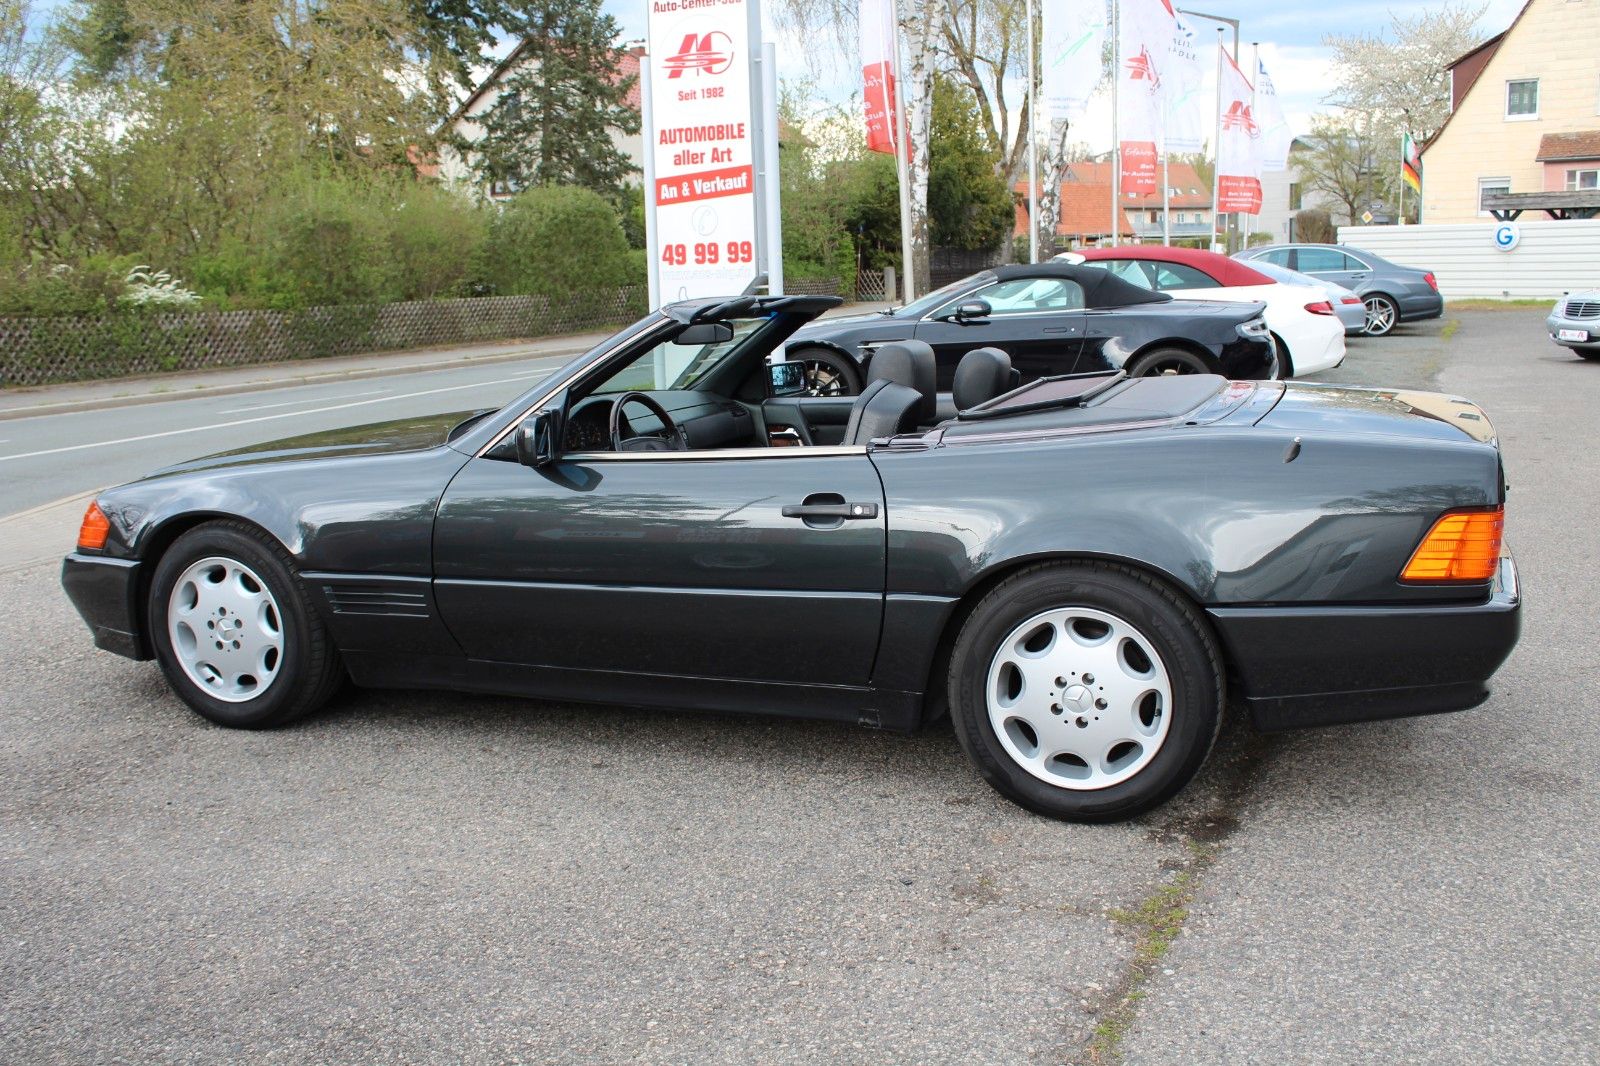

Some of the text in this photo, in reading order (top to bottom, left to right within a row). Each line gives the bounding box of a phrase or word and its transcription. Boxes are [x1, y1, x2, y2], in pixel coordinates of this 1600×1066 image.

[678, 87, 724, 101] Seit 1982
[659, 123, 745, 145] AUTOMOBILE
[674, 147, 732, 166] aller Art
[661, 172, 748, 200] An & Verkauf
[662, 241, 752, 266] 49 99 99
